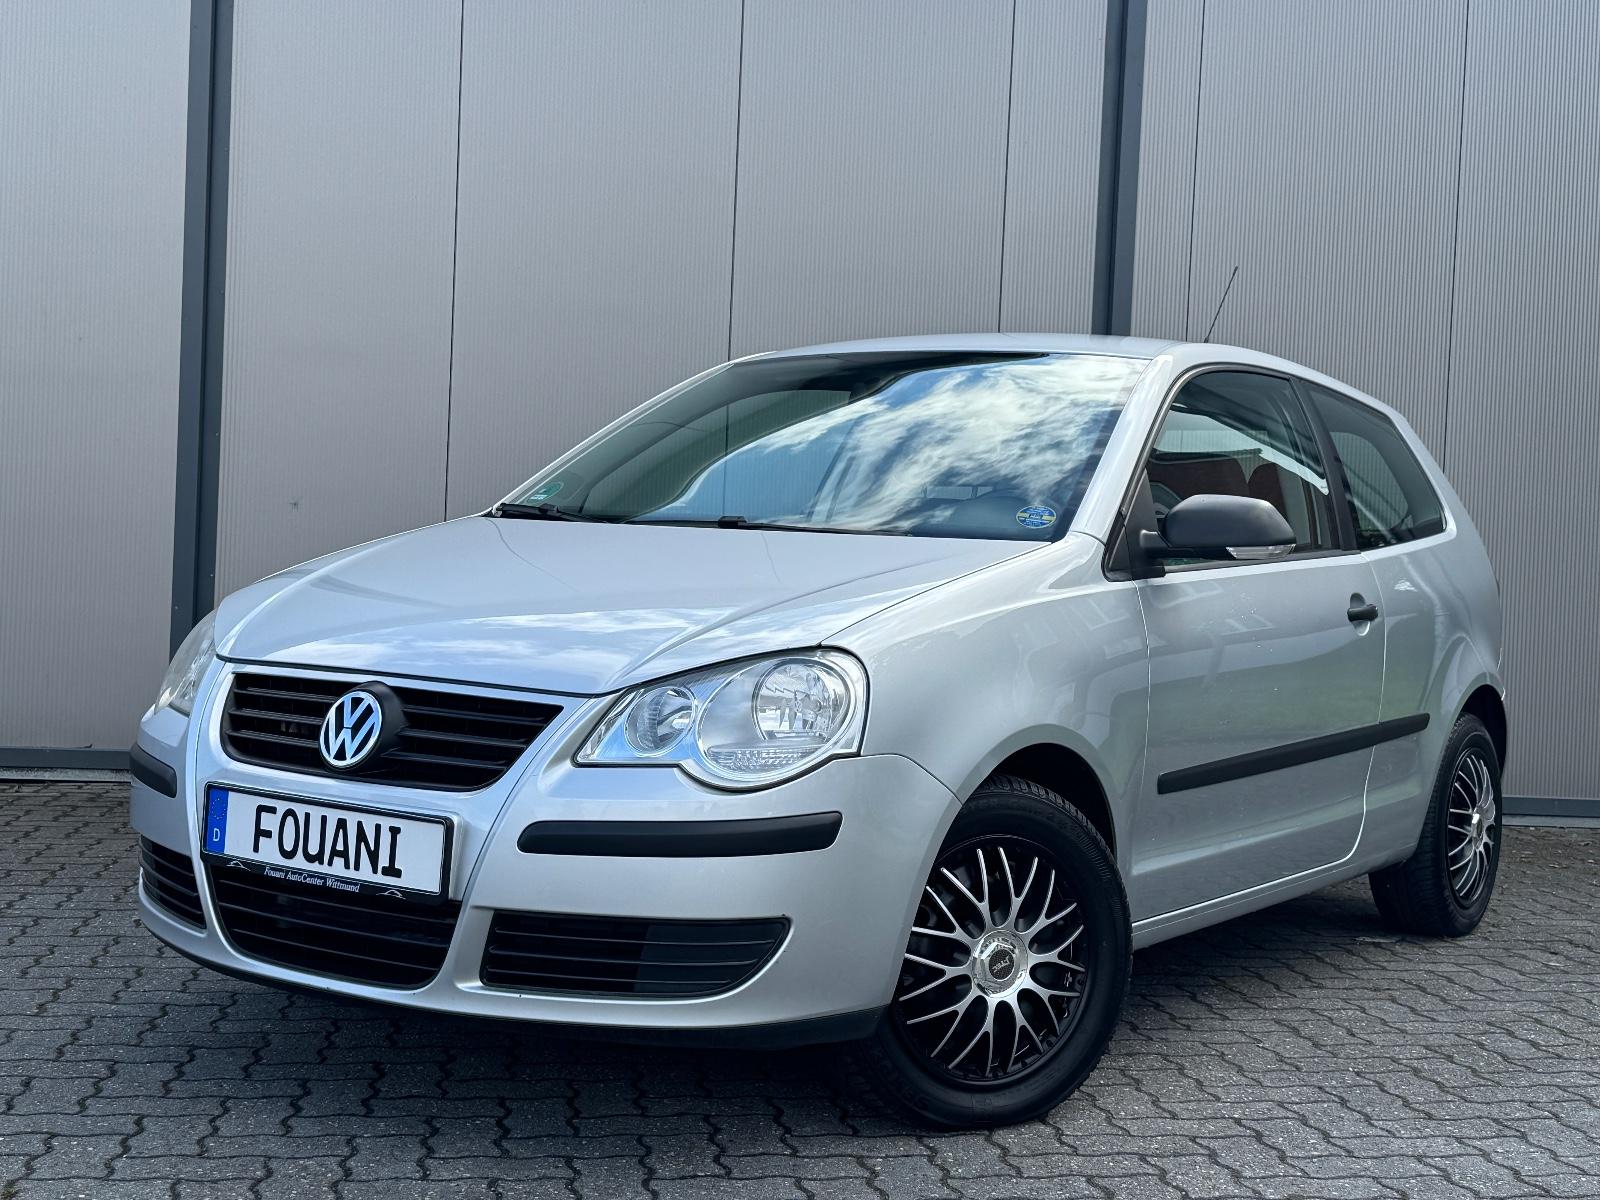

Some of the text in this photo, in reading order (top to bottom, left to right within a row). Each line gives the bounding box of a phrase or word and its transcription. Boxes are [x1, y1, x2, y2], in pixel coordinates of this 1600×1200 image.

[320, 691, 382, 767] VW
[212, 828, 221, 842] D
[252, 804, 403, 879] FOUANI
[263, 866, 361, 893] Fouani AutoCenter Wittmund
